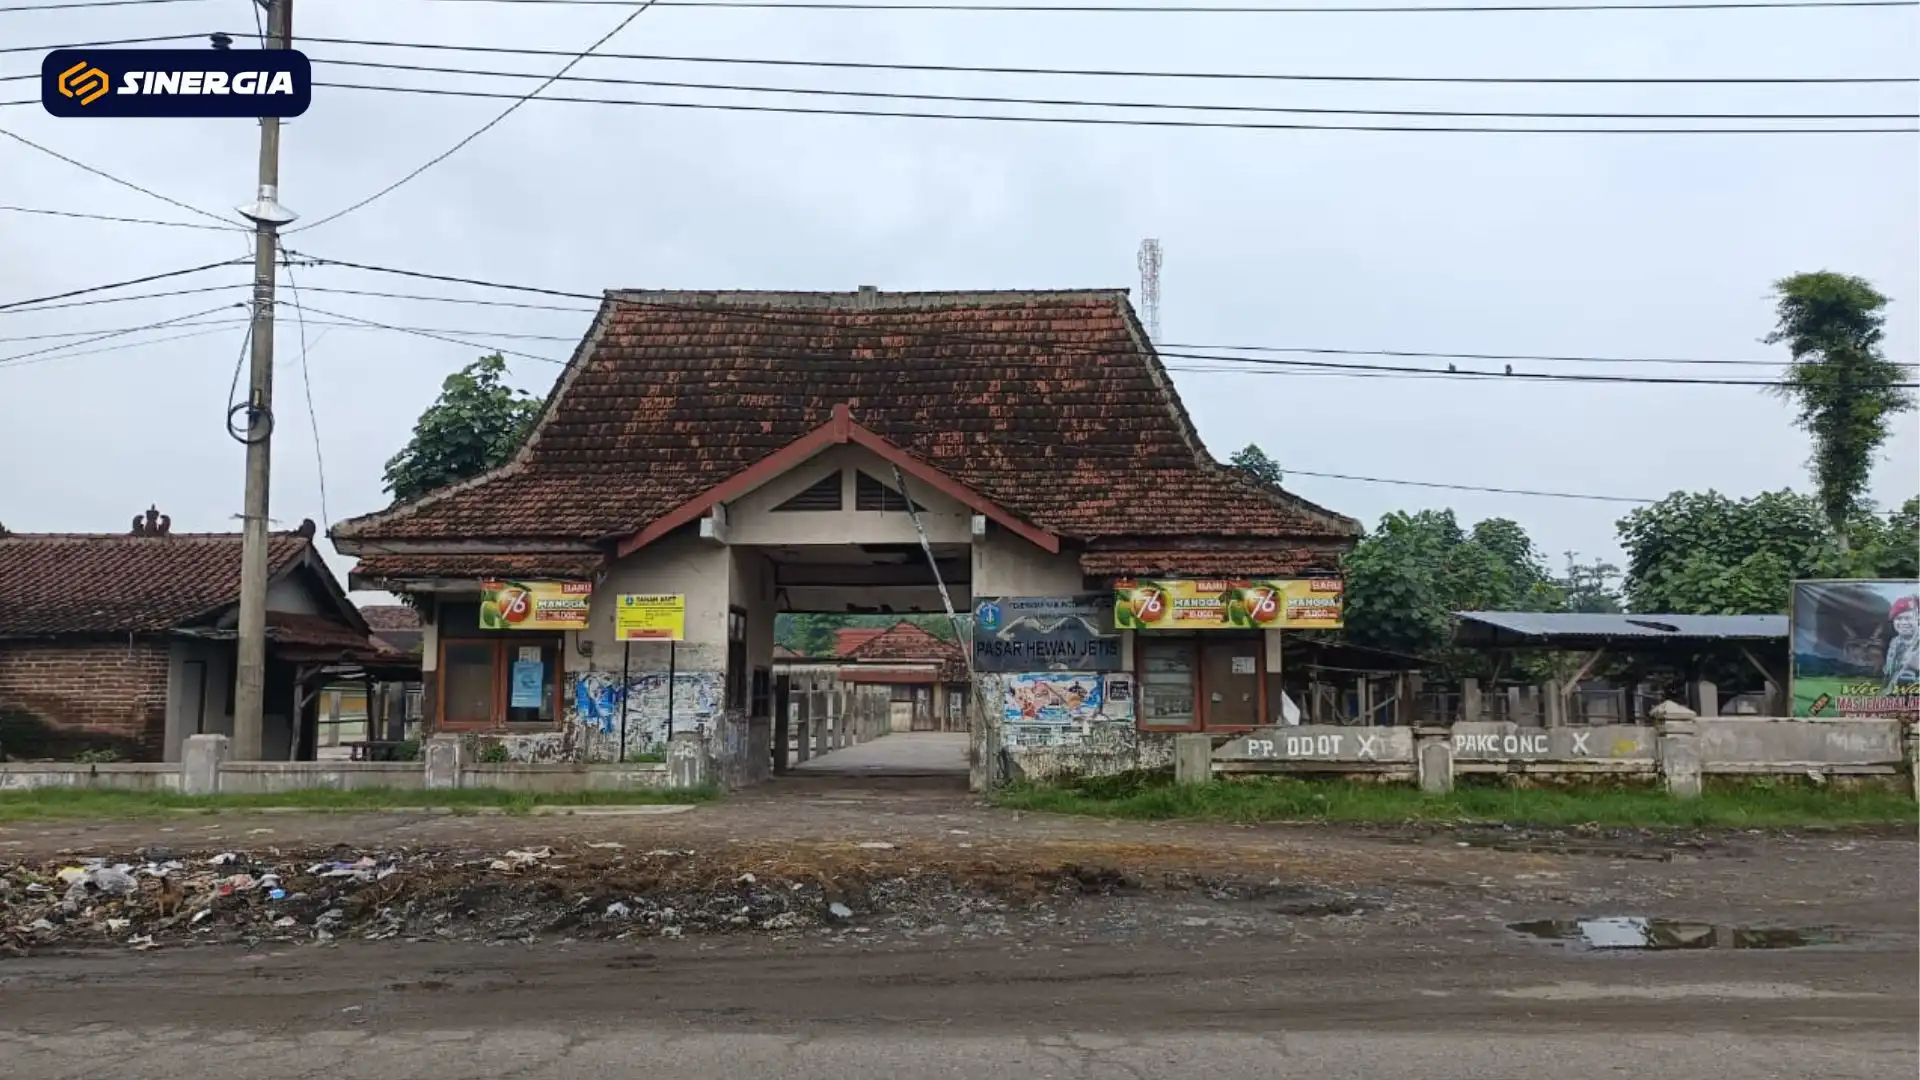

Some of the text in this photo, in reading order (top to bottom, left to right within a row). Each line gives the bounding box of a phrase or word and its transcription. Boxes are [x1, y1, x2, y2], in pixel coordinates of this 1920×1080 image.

[977, 640, 1119, 658] PASAR HEWAN JETIS
[1287, 735, 1343, 756] ODOT
[1358, 735, 1376, 758] X
[1572, 732, 1590, 754] X
